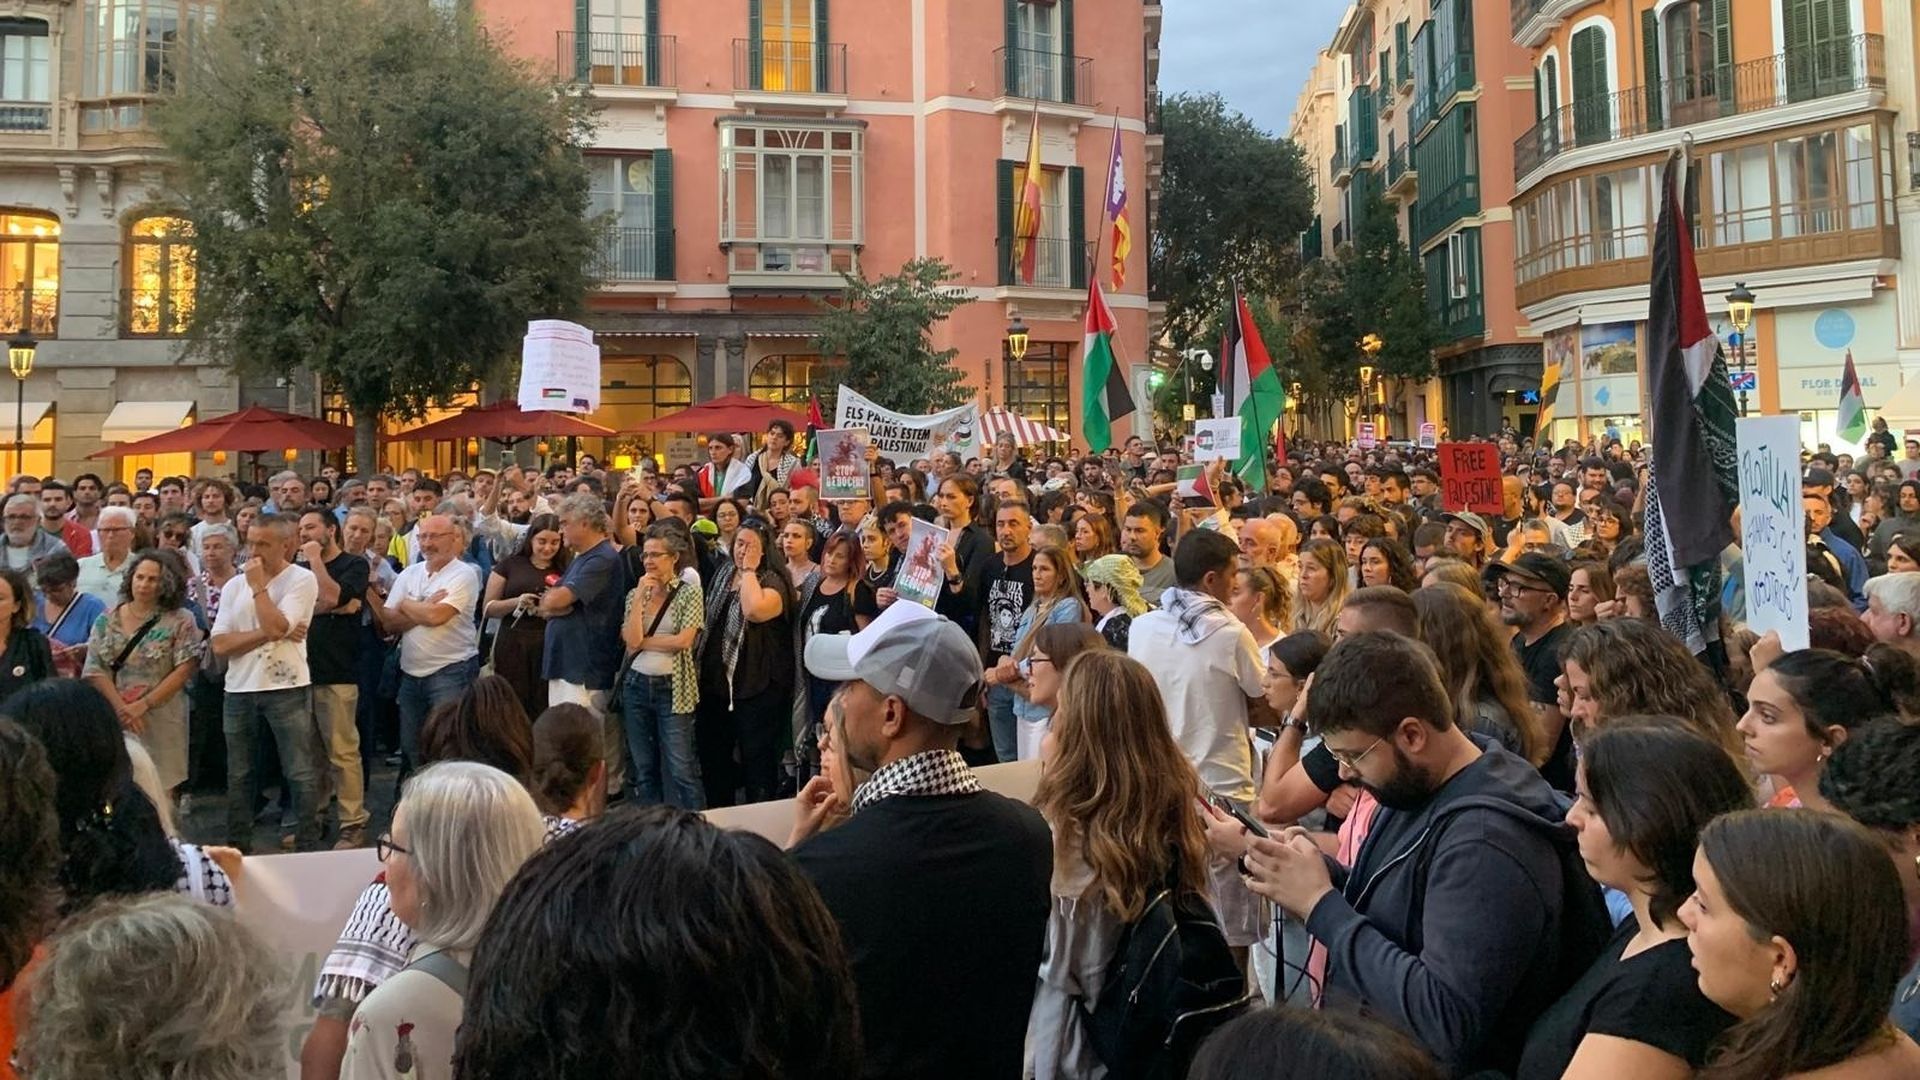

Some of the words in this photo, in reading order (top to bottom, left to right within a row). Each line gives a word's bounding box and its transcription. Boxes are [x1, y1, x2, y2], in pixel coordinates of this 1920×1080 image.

[1801, 379, 1832, 389] FLOR
[1861, 377, 1877, 387] AL
[846, 406, 864, 420] ELS
[901, 427, 931, 440] ESTEM
[871, 438, 926, 453] PALESTINA!
[1453, 448, 1486, 473] FREE
[835, 465, 855, 476] STOP
[1447, 477, 1499, 505] PALESTINE
